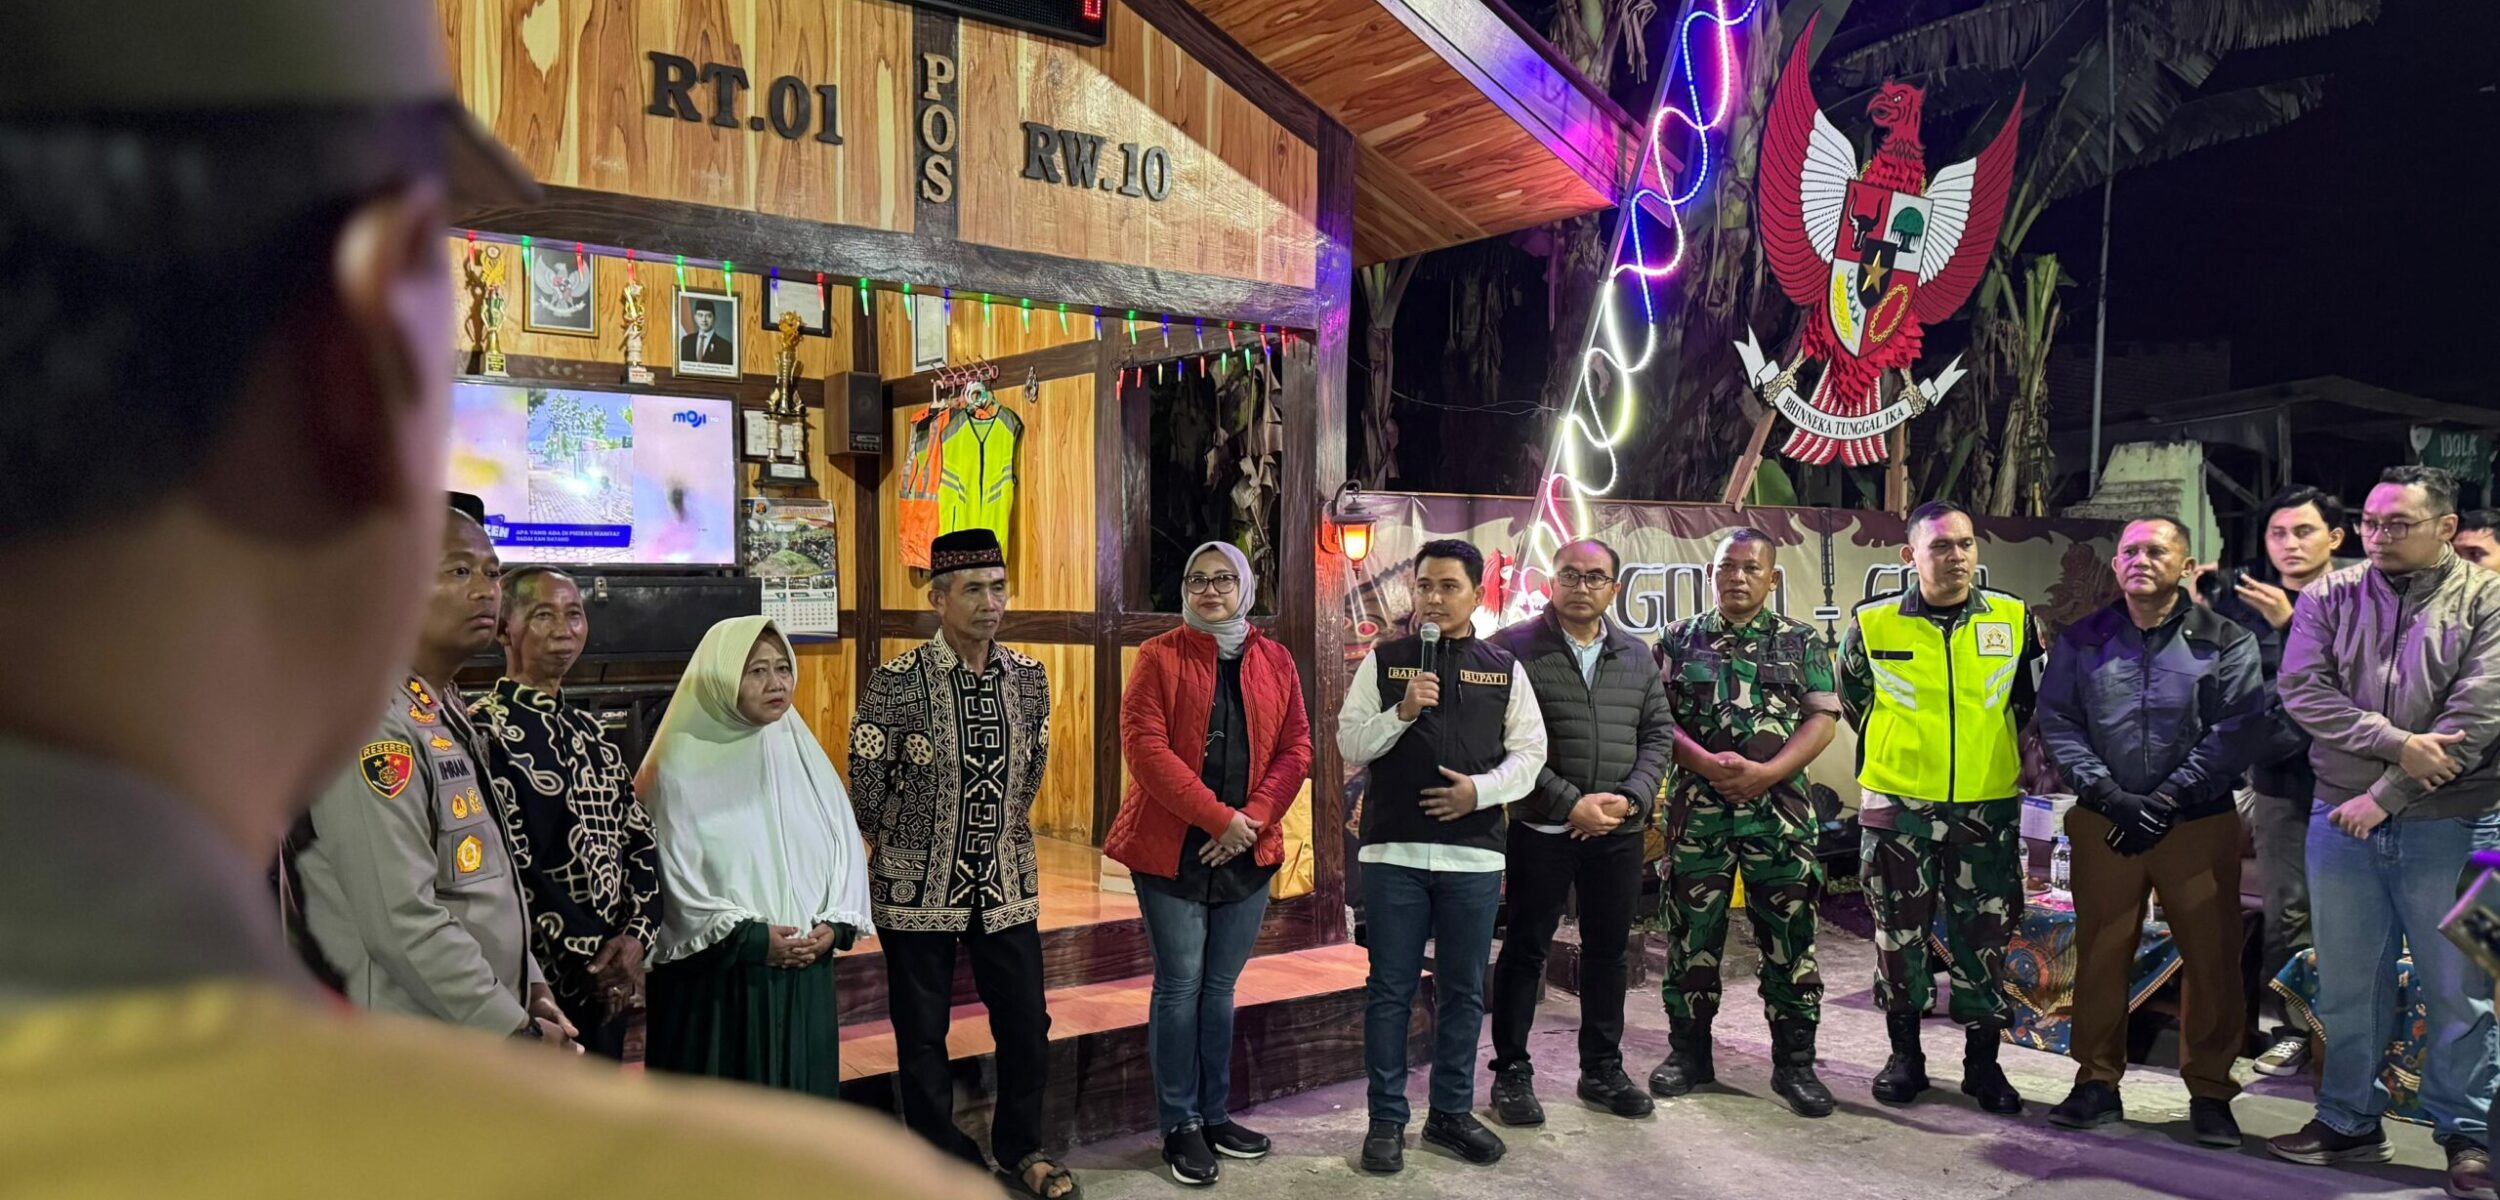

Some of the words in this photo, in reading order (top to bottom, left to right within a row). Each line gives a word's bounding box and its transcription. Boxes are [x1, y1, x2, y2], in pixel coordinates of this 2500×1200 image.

[645, 49, 844, 146] RT.01
[921, 51, 955, 204] POS
[1021, 121, 1173, 201] RW.10
[1783, 396, 1832, 434] BHINNEKA
[1835, 418, 1882, 435] TUNGGAL
[1885, 407, 1904, 425] IKA
[1464, 671, 1505, 684] BUPATI
[363, 743, 408, 758] RESERSE
